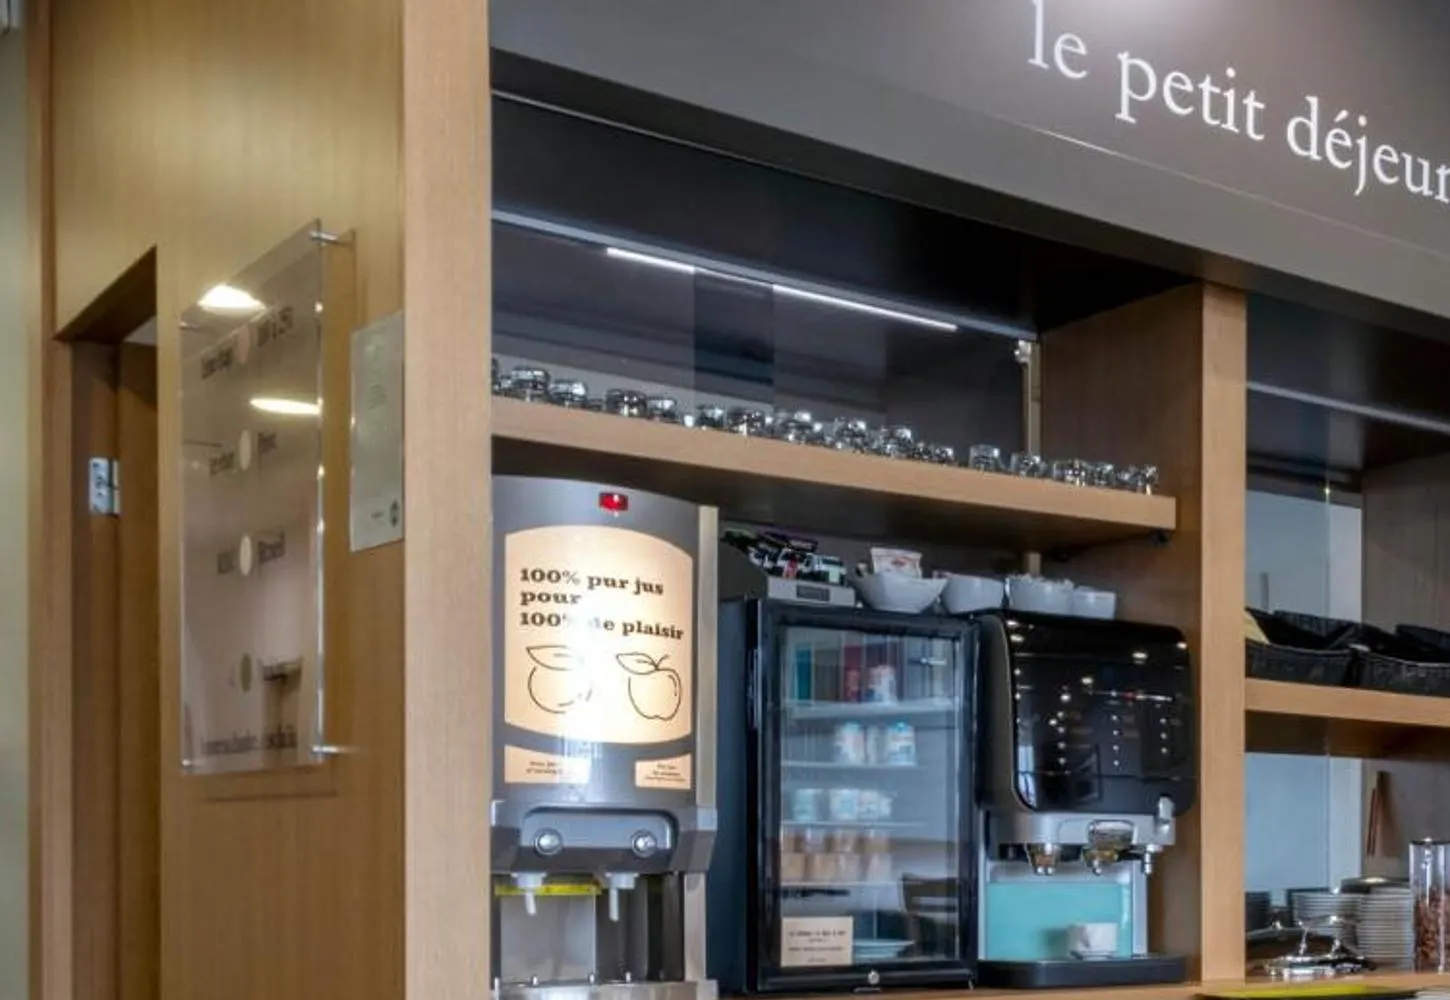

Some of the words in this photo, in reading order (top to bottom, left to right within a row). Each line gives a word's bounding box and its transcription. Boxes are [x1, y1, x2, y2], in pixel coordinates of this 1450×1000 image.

[1028, 0, 1088, 79] le
[1115, 51, 1266, 141] petit
[520, 568, 581, 585] 100%
[587, 575, 629, 590] pur
[633, 577, 664, 595] jus
[520, 590, 582, 606] pour
[520, 612, 573, 627] 100
[622, 620, 684, 640] plaisir
